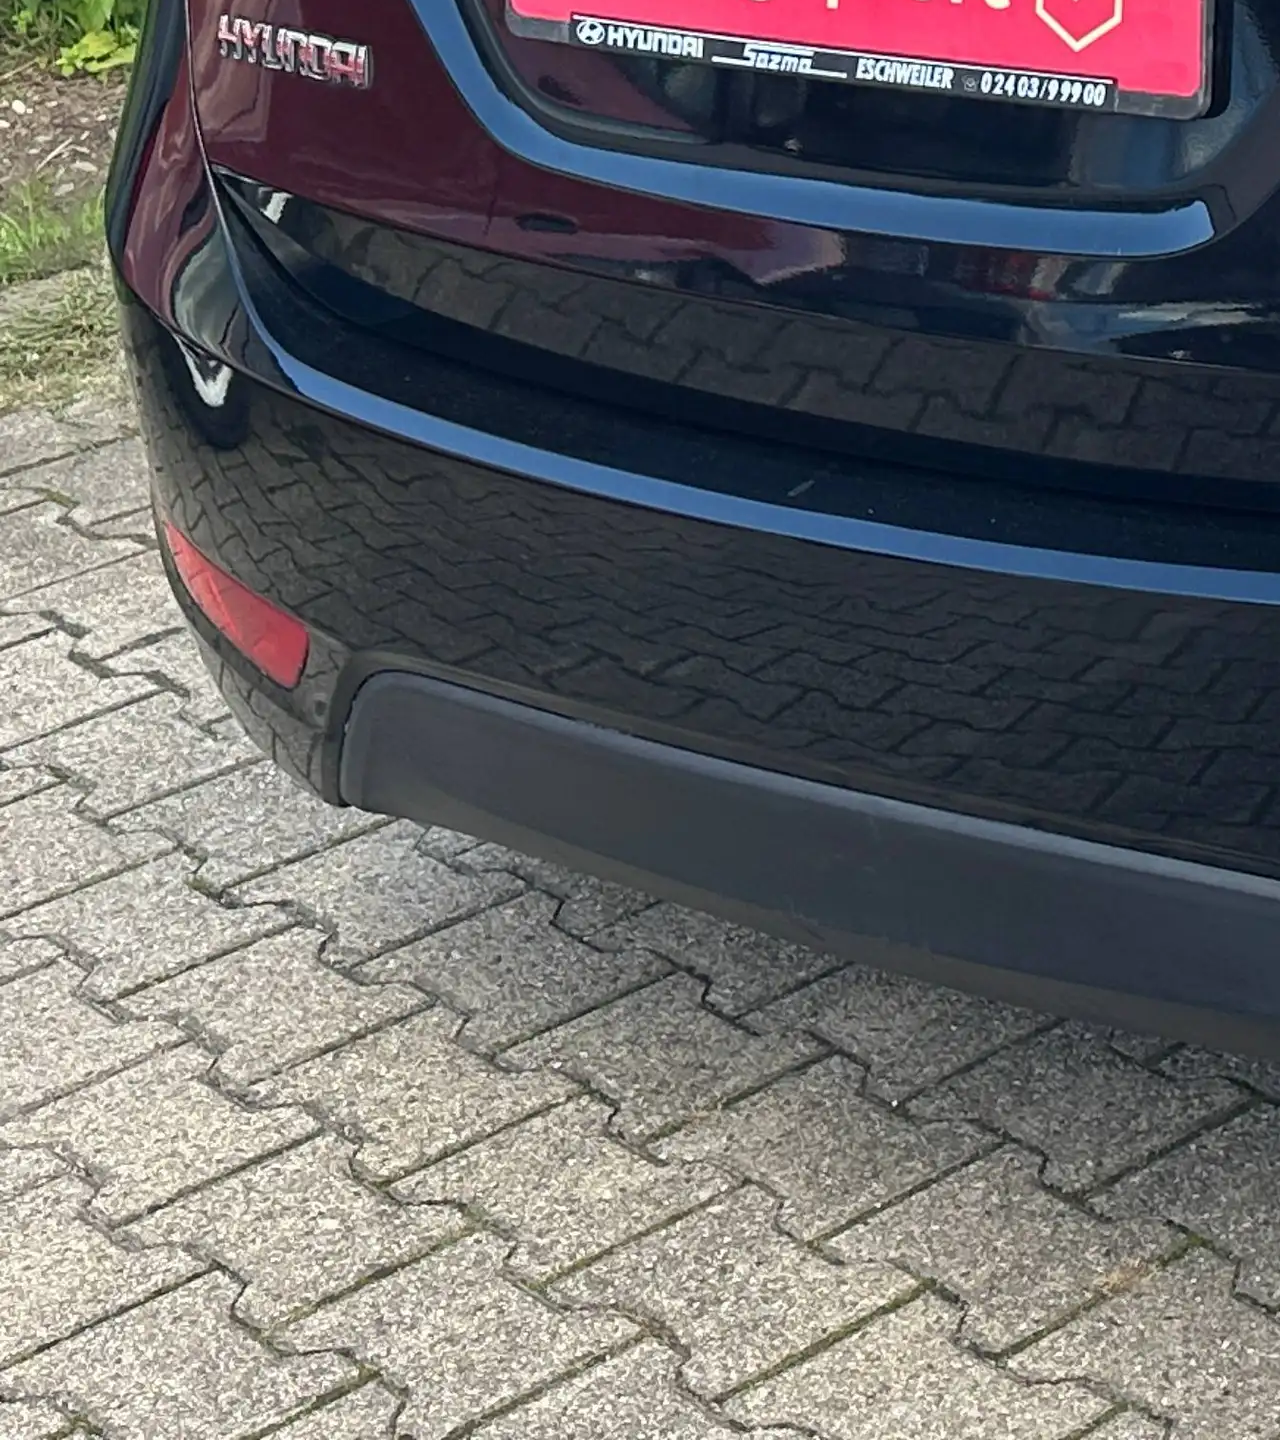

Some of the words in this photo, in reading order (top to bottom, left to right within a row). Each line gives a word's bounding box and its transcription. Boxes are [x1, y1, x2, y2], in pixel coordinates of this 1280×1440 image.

[218, 14, 373, 90] HYUNDAI
[607, 25, 704, 58] HYUNDAI
[855, 58, 955, 89] ESCHWEILER
[980, 72, 1107, 106] 02403/99900
